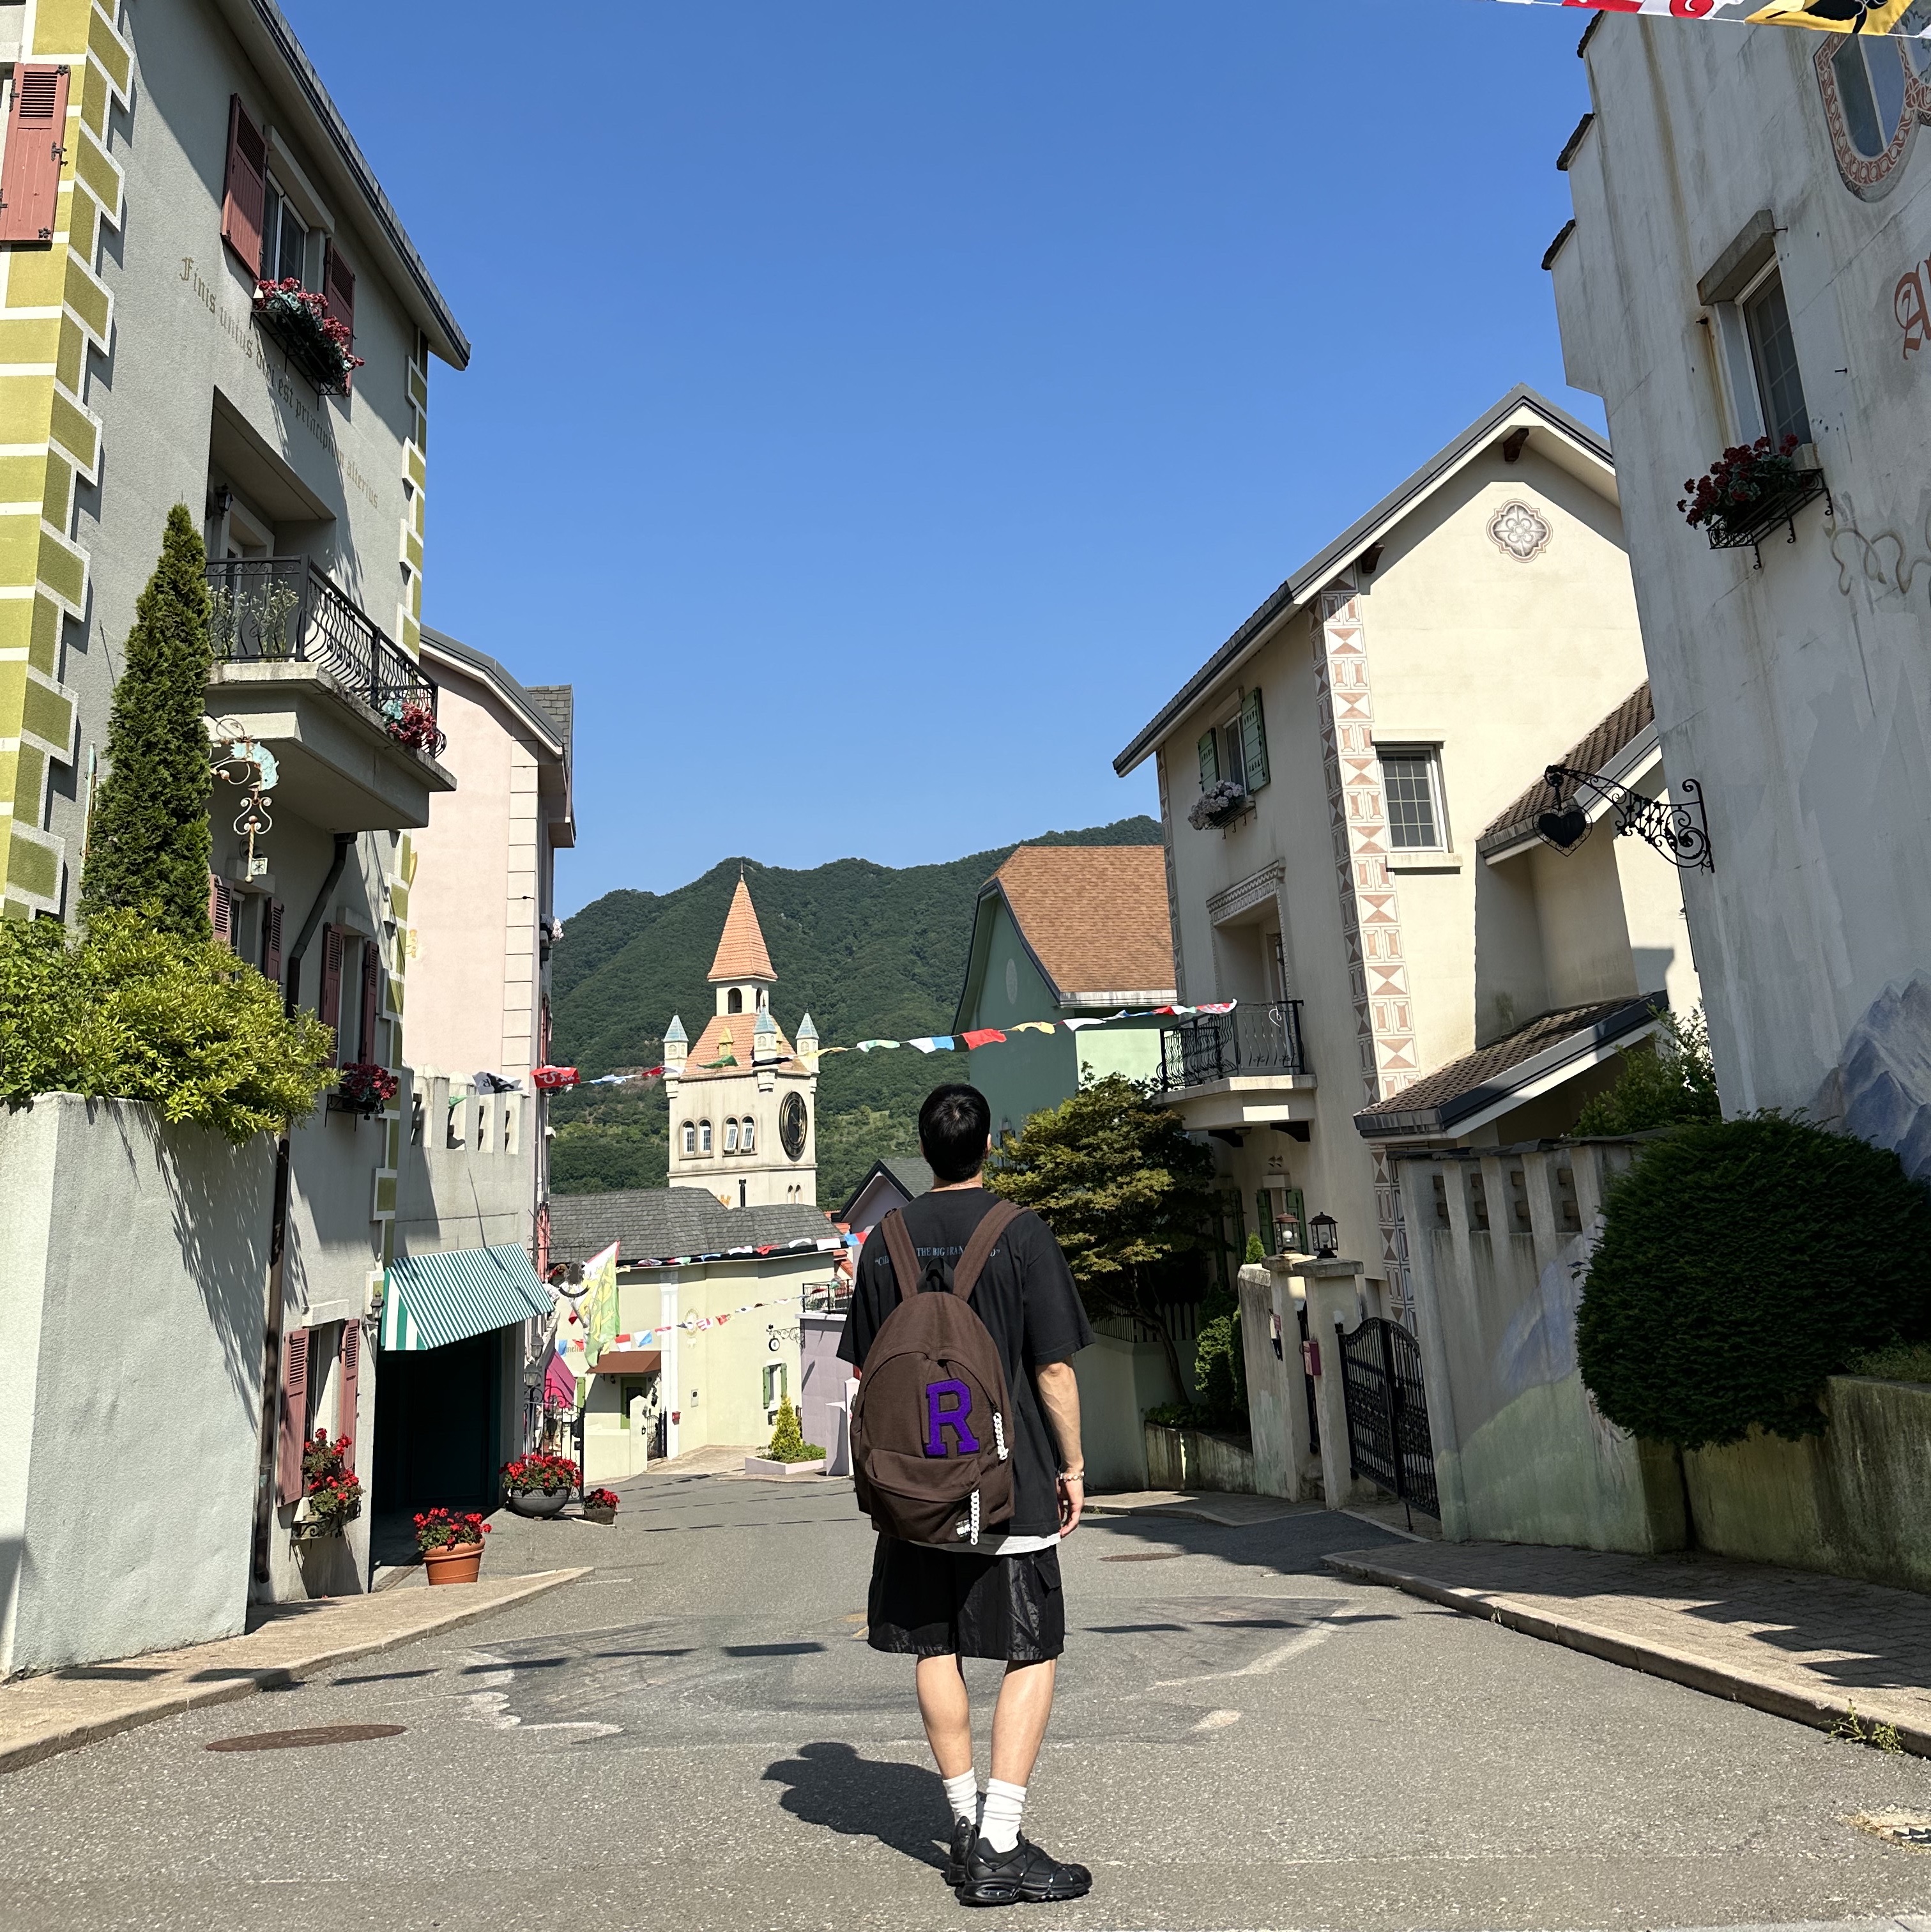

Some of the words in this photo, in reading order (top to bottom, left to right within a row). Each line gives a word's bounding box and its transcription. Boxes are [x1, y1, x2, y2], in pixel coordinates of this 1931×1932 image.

[179, 257, 217, 314] Finis
[278, 379, 293, 408] est
[916, 1247, 931, 1257] THE
[933, 1247, 945, 1257] BIG
[947, 1245, 964, 1255] BRAN
[925, 1377, 981, 1459] R
